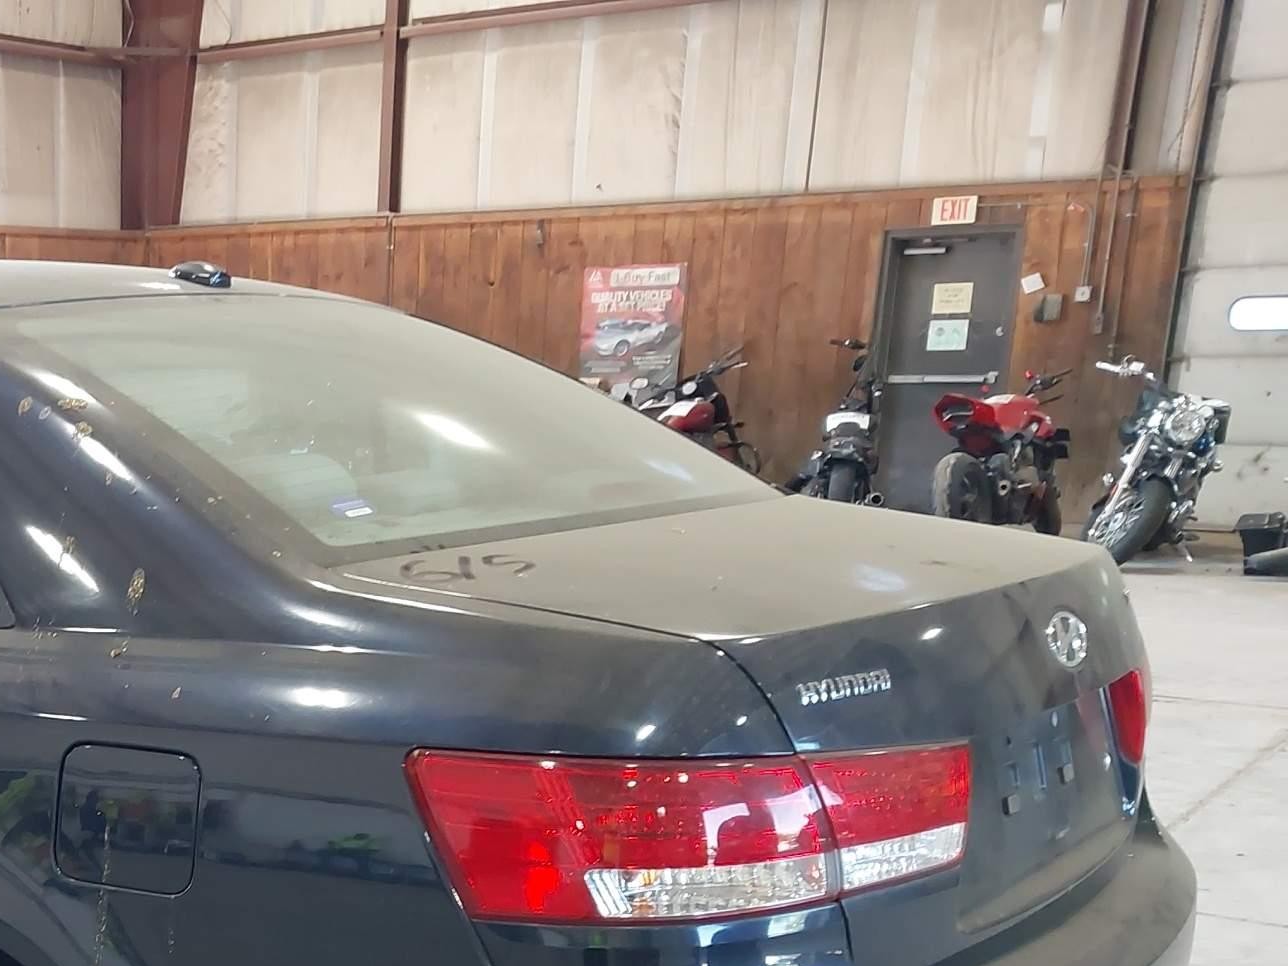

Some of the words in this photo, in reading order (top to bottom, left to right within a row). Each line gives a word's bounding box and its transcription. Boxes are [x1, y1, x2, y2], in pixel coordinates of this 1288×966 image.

[940, 198, 971, 221] EXIT
[647, 270, 671, 281] Fast
[629, 289, 673, 302] VEHICLES
[795, 668, 891, 706] HYUNDAI
